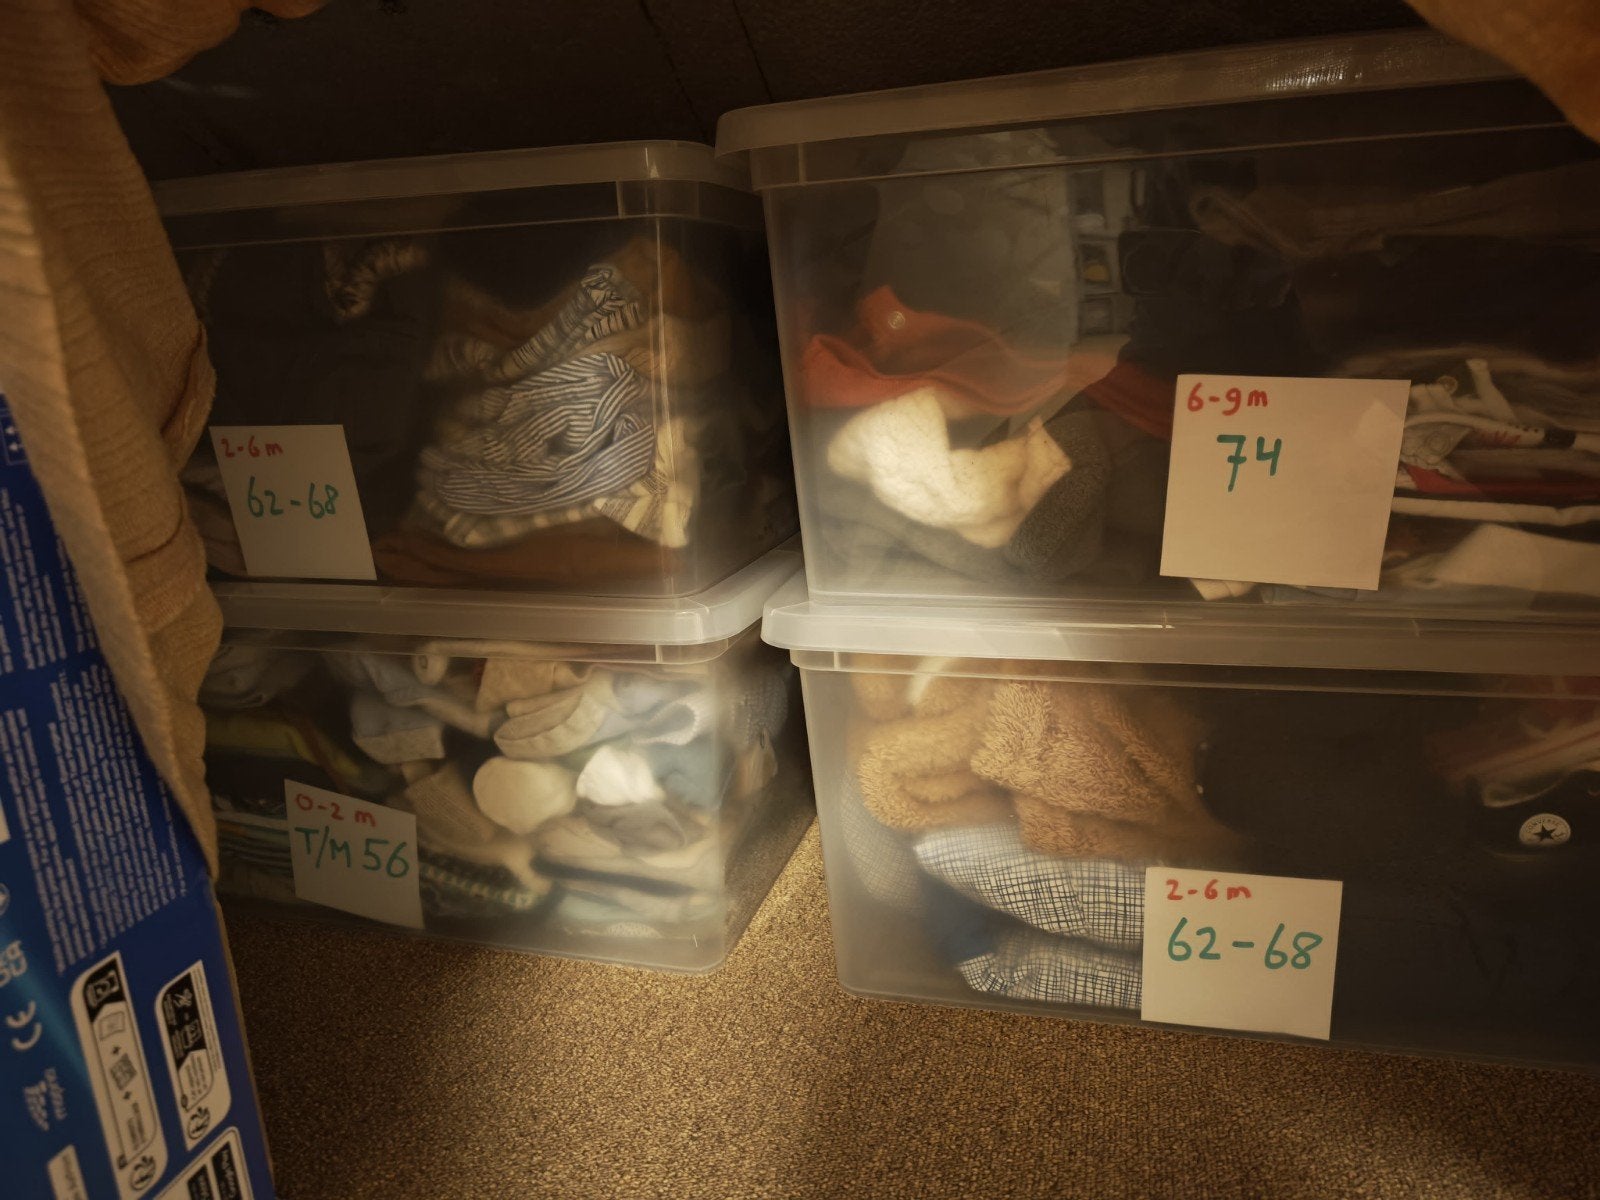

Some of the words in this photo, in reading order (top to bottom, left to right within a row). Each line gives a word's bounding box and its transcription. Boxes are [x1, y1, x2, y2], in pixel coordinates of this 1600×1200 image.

[1216, 434, 1282, 492] 74
[247, 476, 339, 519] 62-68
[294, 825, 351, 869] T/M
[362, 838, 410, 878] 56
[1167, 917, 1323, 969] 62-68
